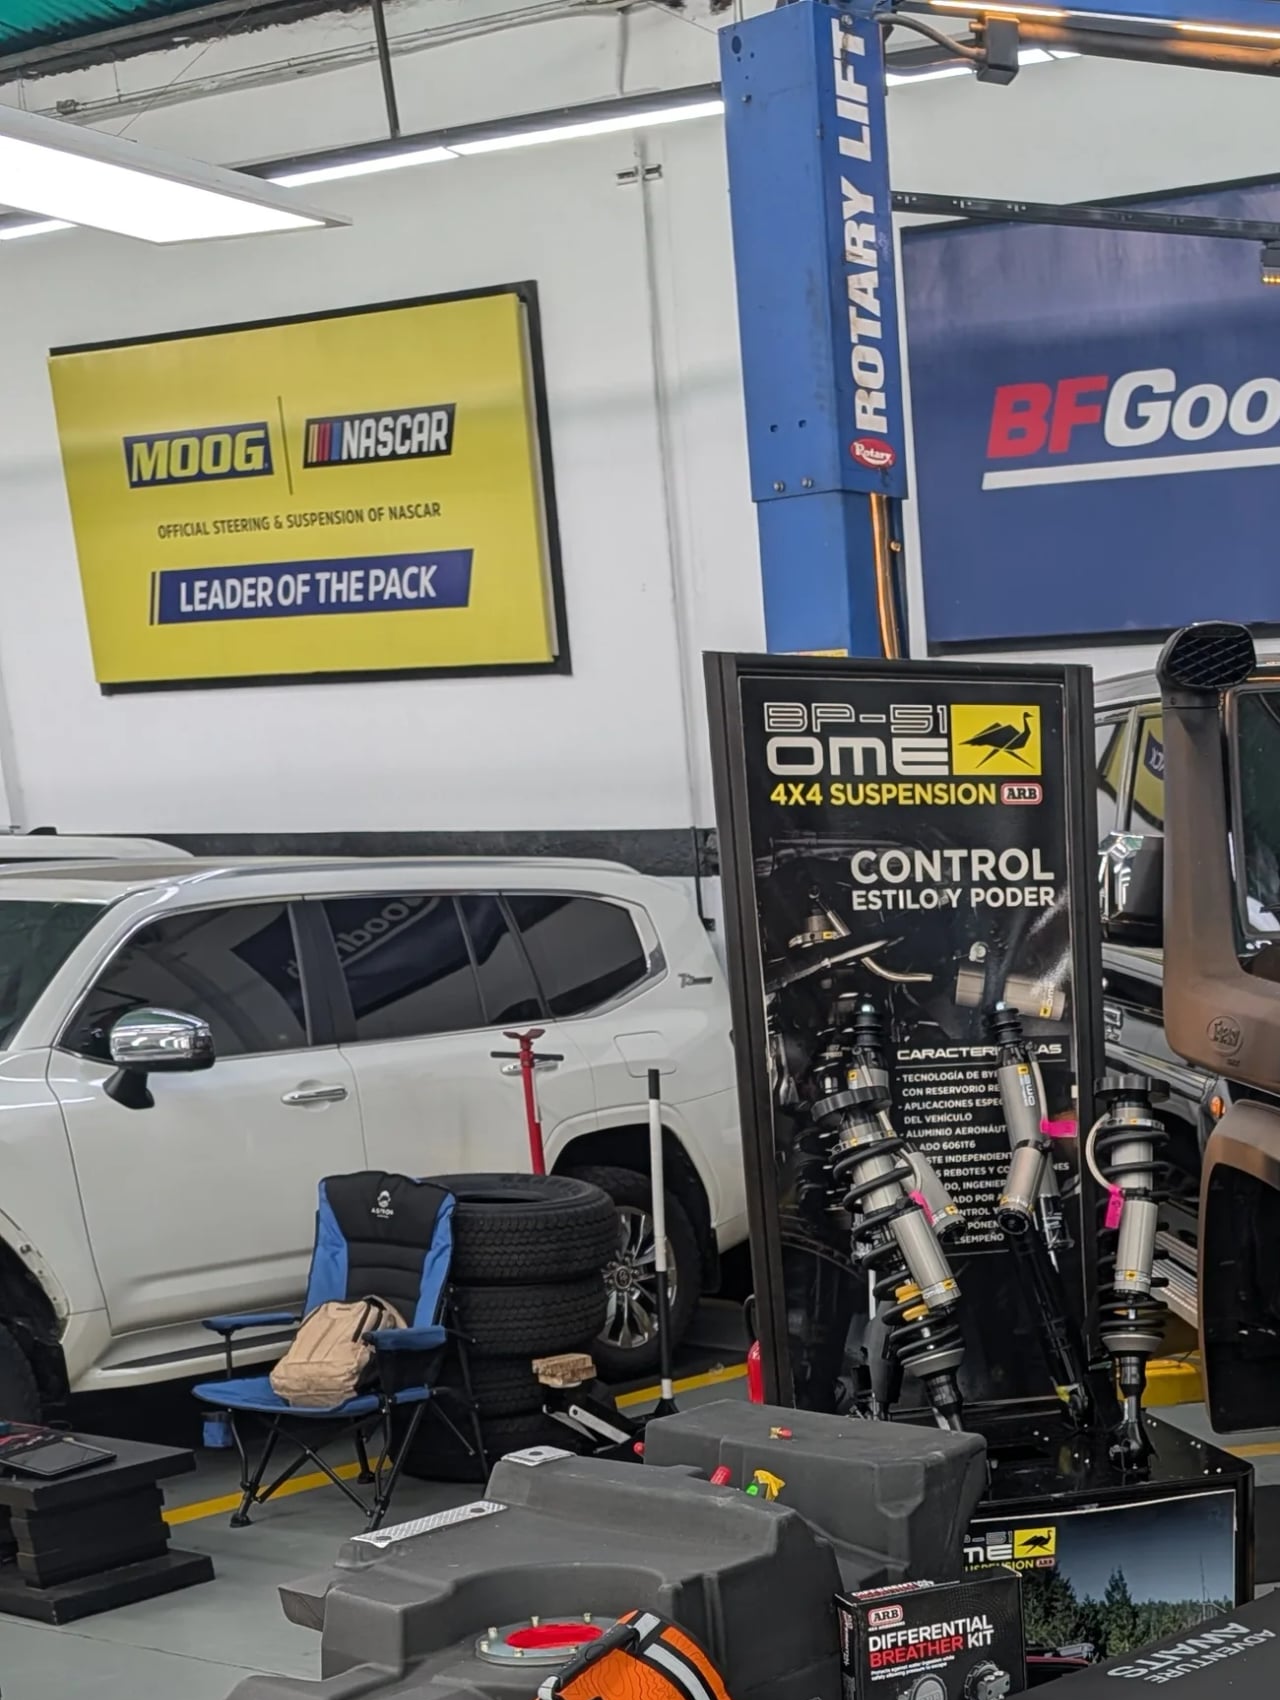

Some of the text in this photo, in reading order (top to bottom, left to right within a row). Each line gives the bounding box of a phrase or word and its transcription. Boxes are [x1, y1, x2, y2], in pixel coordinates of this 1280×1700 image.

[832, 18, 888, 434] ROTARY LIFT
[340, 410, 449, 461] NASCAR
[131, 429, 265, 483] MOOG
[853, 441, 893, 466] Rotary
[157, 502, 441, 540] OFFICIAL STEERING & SUSPENSION OF NASCAR
[179, 564, 437, 613] LEADER OF THE PACK
[764, 702, 947, 733] BP-51
[766, 736, 949, 776] OME
[770, 783, 823, 806] 4X4
[830, 783, 996, 805] SUSPENSION
[850, 848, 1054, 884] CONTROL
[852, 886, 1056, 911] ESTILO Y PODER
[902, 1070, 964, 1083] TECNOLOGÍA
[966, 1070, 979, 1080] DE
[902, 1087, 923, 1097] CON
[925, 1085, 985, 1096] RESERVORIO
[904, 1099, 973, 1111] APLICACIONES
[904, 1112, 973, 1124] DEL VEHÍCULO
[906, 1124, 1006, 1138] ALUMINIO AERONÁUT
[945, 1152, 1012, 1164] INDEPENDIENT
[943, 1166, 996, 1177] REBOTES Y
[962, 1180, 1007, 1189] INGENIER
[975, 1194, 996, 1202] POR
[957, 1232, 1004, 1244] SEMPEÑO
[963, 1544, 1012, 1563] ME
[869, 1614, 993, 1652] DIFFERENTIAL
[870, 1636, 964, 1668] BREATHER
[967, 1629, 994, 1649] KIT
[1107, 1622, 1250, 1679] AWAITS
[1144, 1629, 1276, 1684] ADVENTURE
